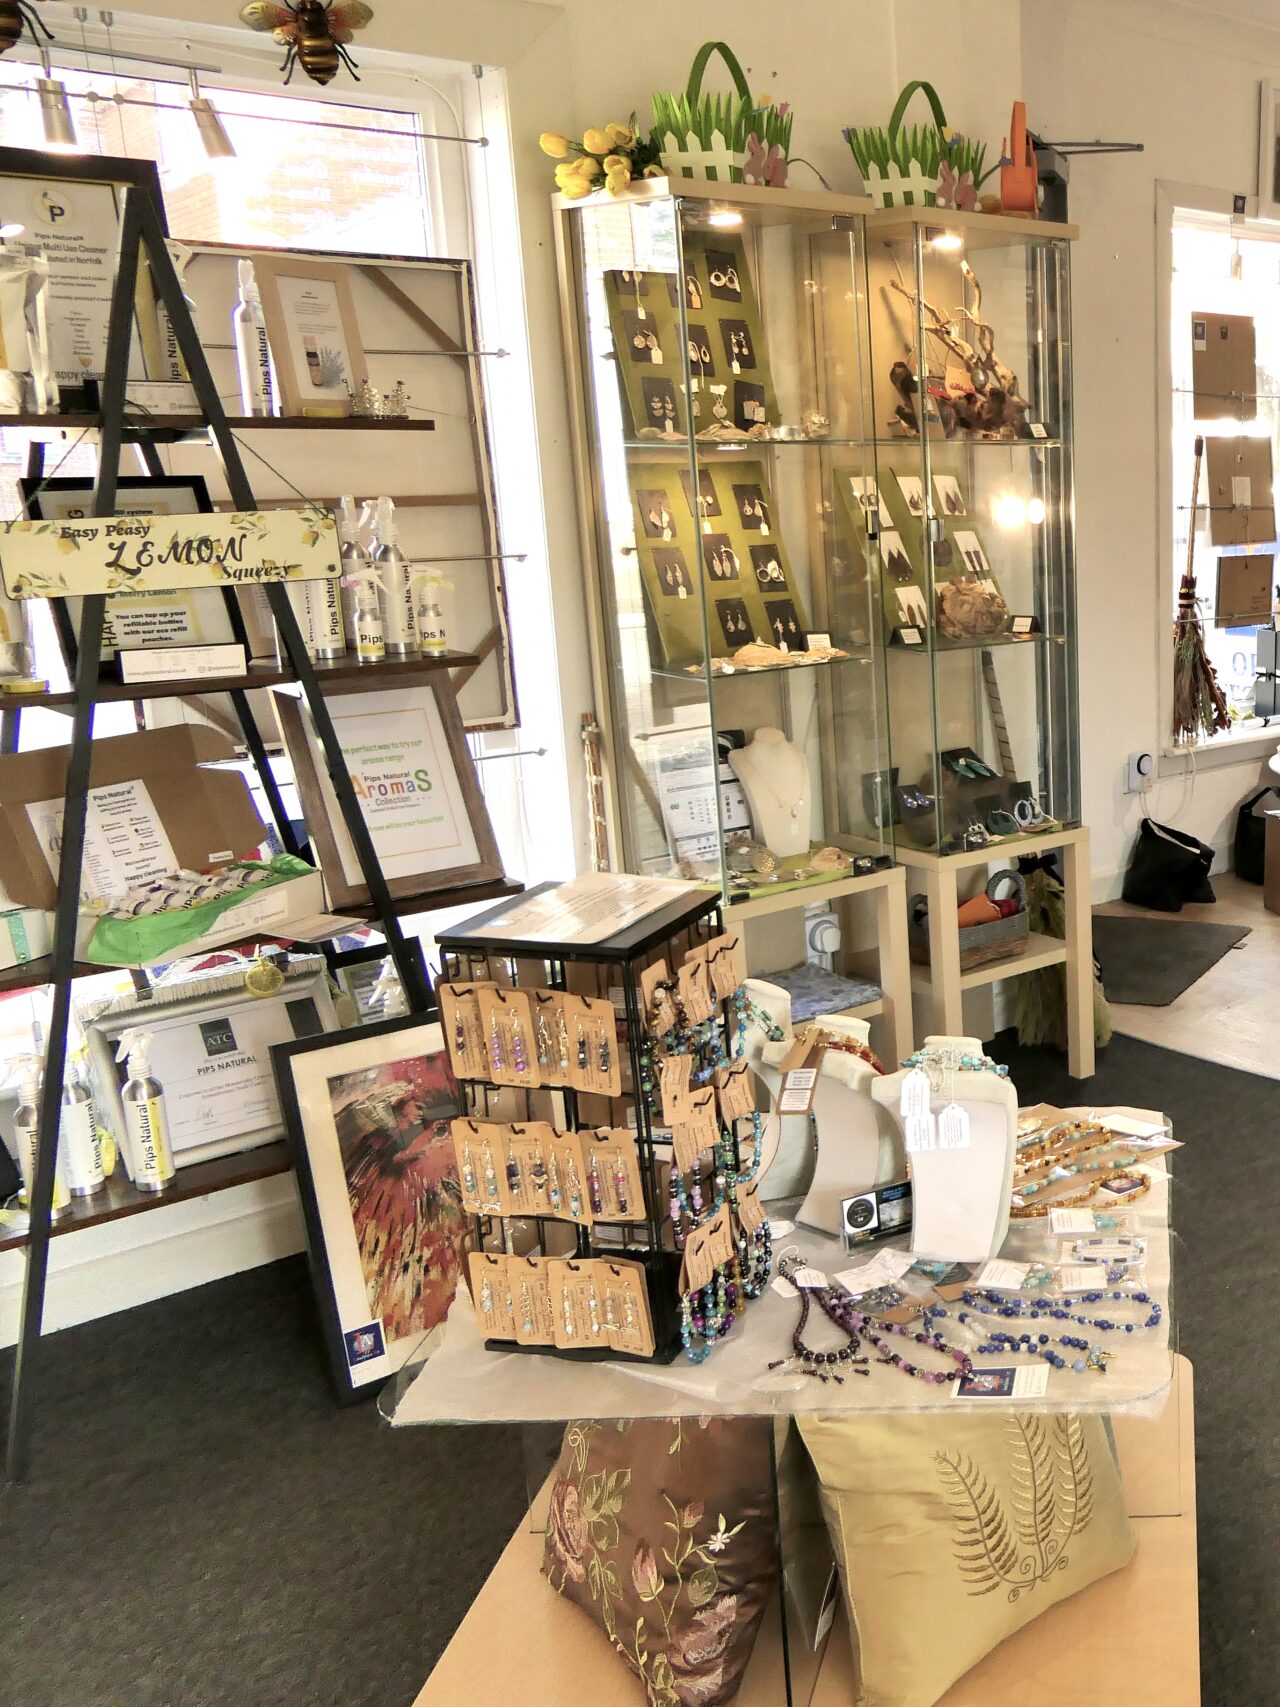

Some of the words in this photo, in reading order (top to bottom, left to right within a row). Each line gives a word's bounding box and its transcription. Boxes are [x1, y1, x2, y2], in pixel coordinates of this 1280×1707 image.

[48, 205, 65, 222] P
[256, 326, 269, 367] Natural
[54, 370, 79, 381] appy
[169, 361, 182, 380] ips
[262, 370, 272, 396] Pips
[60, 526, 98, 541] Easy
[105, 524, 150, 539] Peasy
[105, 533, 248, 576] LEMON
[222, 563, 292, 581] Squeezy
[326, 578, 336, 608] Natur
[123, 620, 157, 628] refillable
[158, 618, 183, 626] bottles
[170, 610, 187, 618] your
[407, 606, 415, 631] Pips
[124, 628, 141, 636] with
[330, 611, 340, 636] Pips
[360, 632, 384, 644] Pips
[421, 630, 437, 641] ips
[383, 771, 411, 780] Natural
[375, 795, 412, 807] Collection
[206, 1032, 233, 1047] ATC
[197, 1064, 216, 1076] PIPS
[218, 1055, 257, 1071] NATURAL
[85, 1102, 97, 1143] Natural
[136, 1103, 152, 1144] Natural
[94, 1144, 102, 1170] Pips
[145, 1145, 156, 1170] Pips
